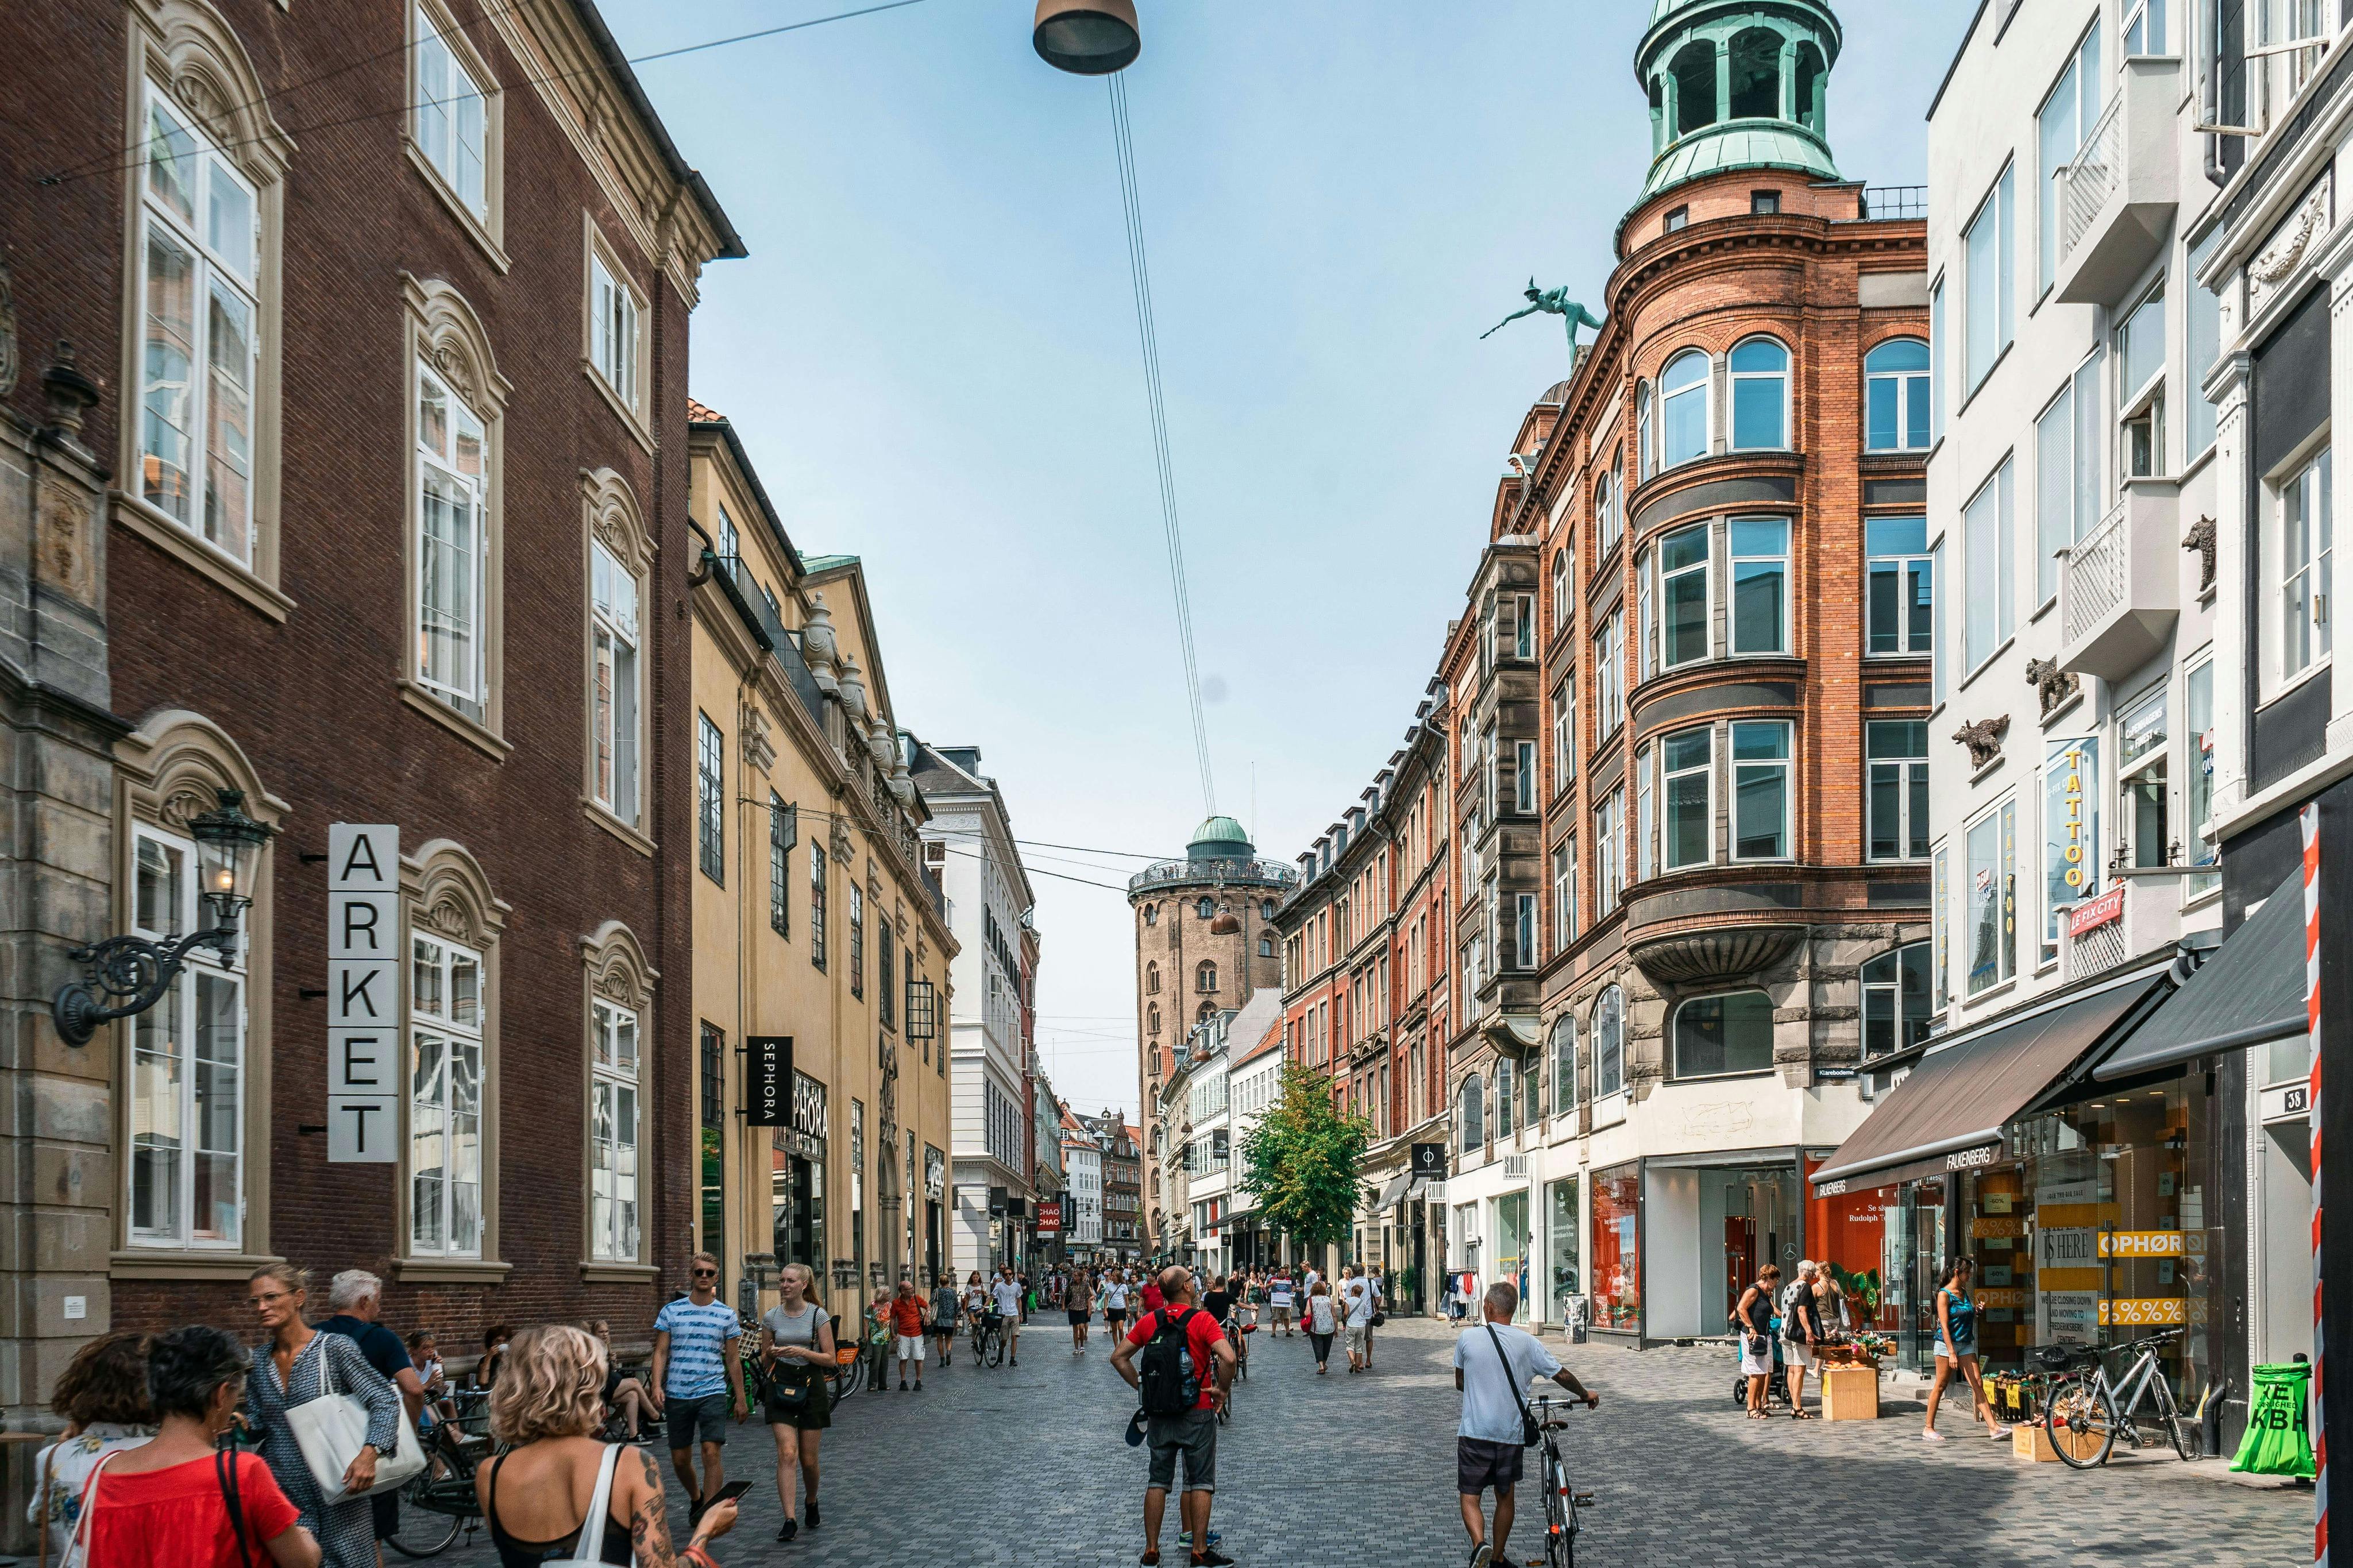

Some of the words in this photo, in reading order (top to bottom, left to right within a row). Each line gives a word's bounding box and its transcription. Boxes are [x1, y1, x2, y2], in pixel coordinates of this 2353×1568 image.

[2065, 751, 2084, 889] TATTOO
[2071, 914, 2081, 931] LE
[2082, 906, 2096, 923] FIX
[2097, 894, 2120, 914] CITY
[341, 834, 383, 1152] ARKET
[763, 1043, 775, 1119] SEPHORA
[2288, 1091, 2301, 1109] 38
[794, 1090, 828, 1141] PHORA
[1505, 1156, 1527, 1174] SAINT
[1946, 1147, 1990, 1170] FALKENBERG
[1428, 1183, 1445, 1198] SAINT
[1819, 1180, 1846, 1197] FALKENBERG
[1849, 1214, 1878, 1223] Rudolph
[2057, 1233, 2088, 1258] HERE
[2100, 1234, 2183, 1253] OPHØR
[2041, 1296, 2048, 1304] WE
[2057, 1296, 2076, 1305] CLOSING
[2077, 1296, 2091, 1306] DOWN
[2059, 1310, 2077, 1318] MOVING
[2077, 1310, 2084, 1318] TO
[2050, 1322, 2084, 1332] FREDERIKSBERG
[2250, 1409, 2306, 1432] KBH
